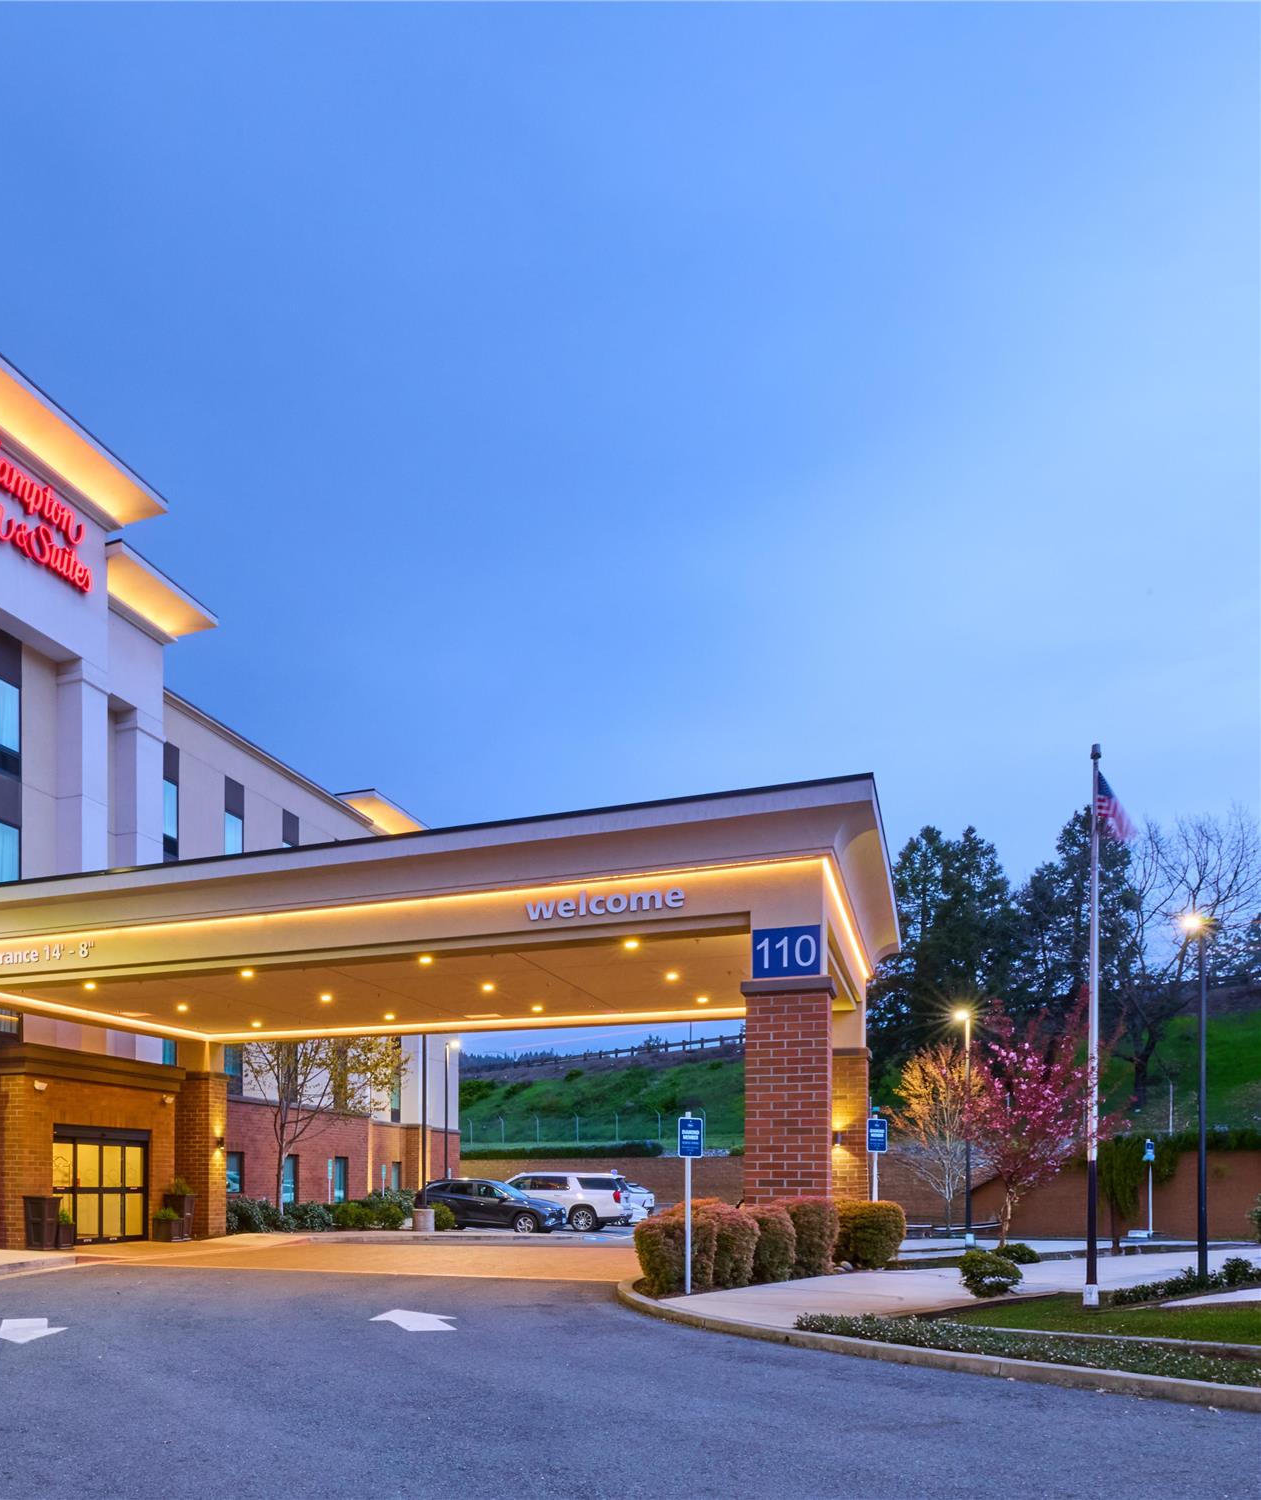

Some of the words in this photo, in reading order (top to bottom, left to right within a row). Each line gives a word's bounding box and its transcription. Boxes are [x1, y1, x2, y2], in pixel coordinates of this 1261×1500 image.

[15, 521, 33, 558] &
[30, 523, 93, 592] Suites
[525, 887, 685, 921] welcome
[756, 934, 817, 969] 110
